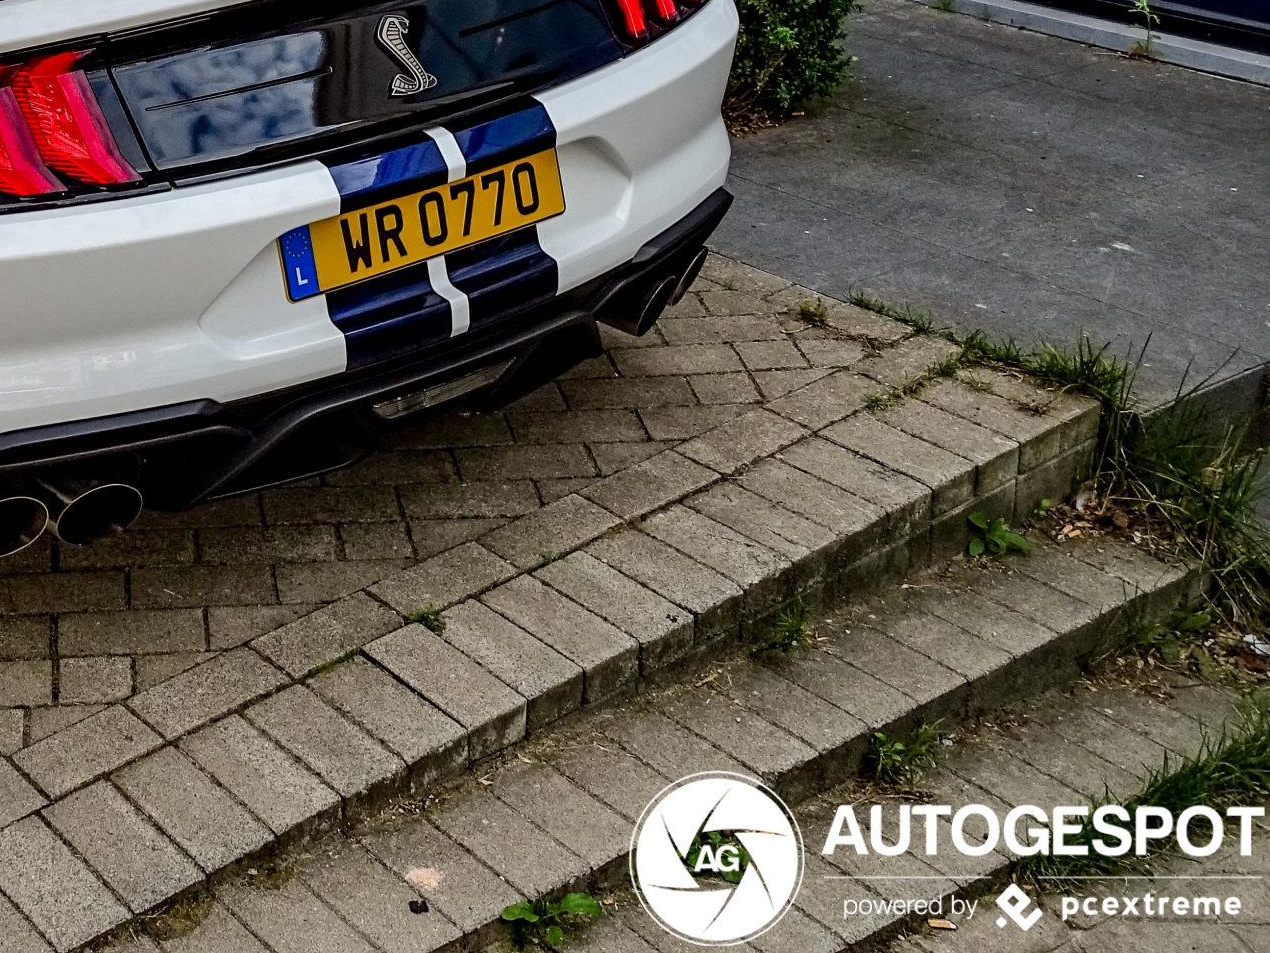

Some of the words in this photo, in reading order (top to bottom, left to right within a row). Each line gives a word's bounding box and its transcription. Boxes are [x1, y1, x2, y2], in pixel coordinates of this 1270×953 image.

[340, 204, 408, 273] WR
[417, 161, 540, 247] 0770
[295, 267, 309, 286] L
